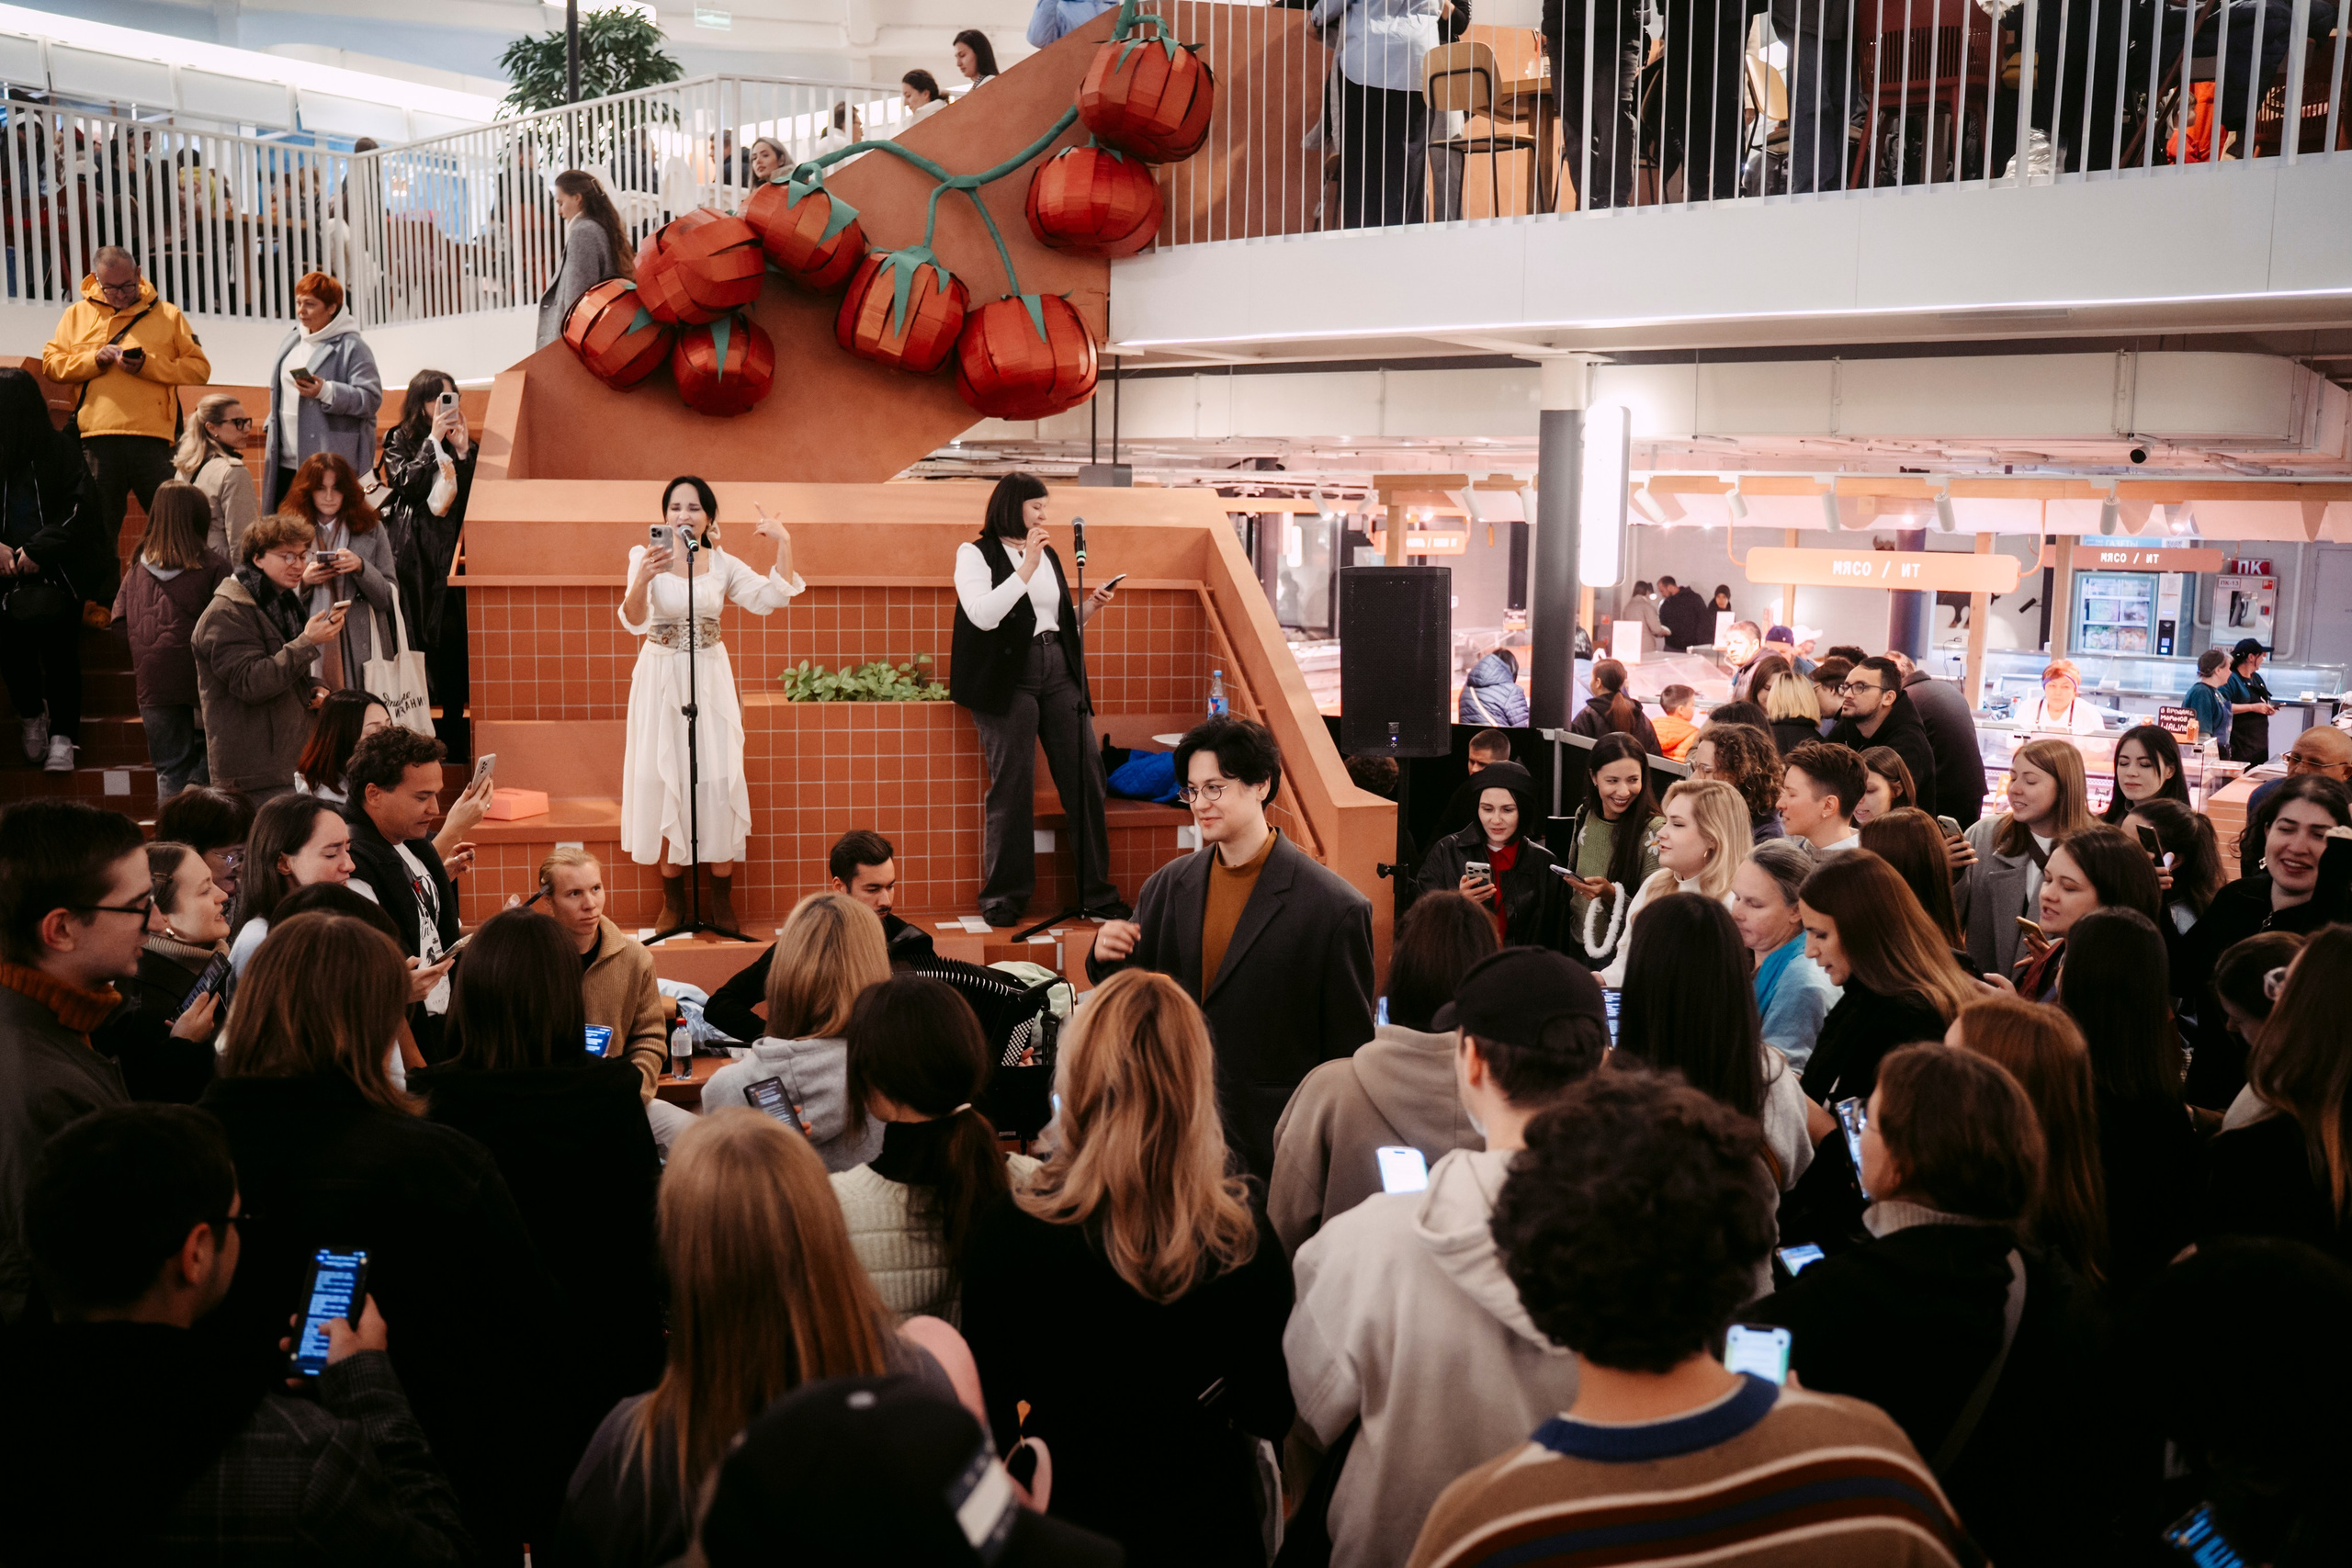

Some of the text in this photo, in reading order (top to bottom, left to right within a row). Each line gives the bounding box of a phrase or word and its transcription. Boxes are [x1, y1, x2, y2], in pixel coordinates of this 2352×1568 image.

[2100, 552, 2160, 565] МЯСО / ИТ
[1832, 560, 1921, 579] МЯСО / ИТ
[2237, 560, 2263, 575] ПК
